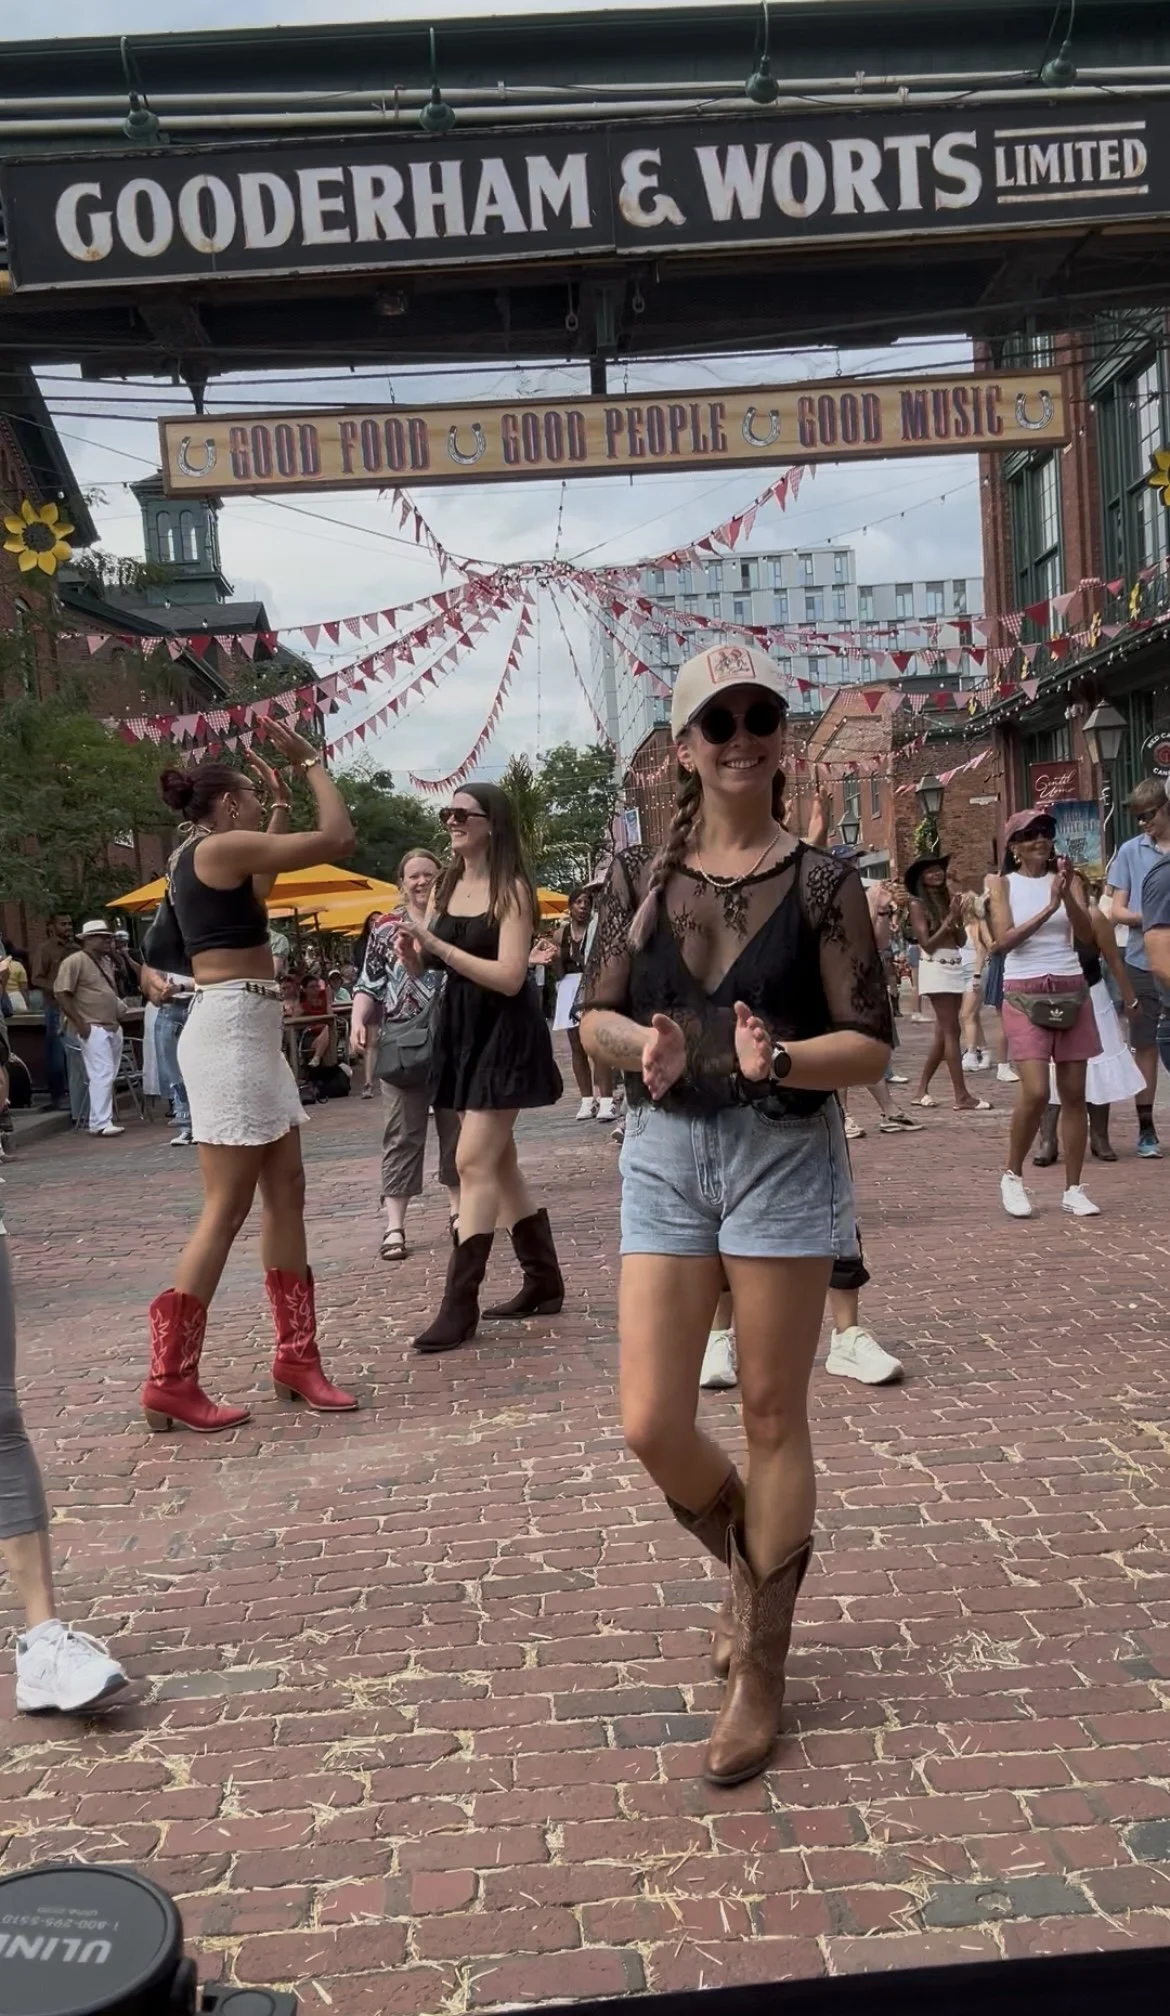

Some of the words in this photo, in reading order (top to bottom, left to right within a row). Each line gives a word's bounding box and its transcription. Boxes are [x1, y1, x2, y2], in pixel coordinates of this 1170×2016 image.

[55, 153, 593, 262] GOODERHAM
[618, 148, 687, 228] &
[694, 130, 983, 222] WORTS
[994, 137, 1148, 188] LIMITED
[229, 422, 322, 480] GOOD
[338, 417, 431, 475] FOOD
[501, 410, 588, 466] GOOD
[603, 401, 729, 460] PEOPLE
[798, 392, 883, 449] GOOD
[900, 384, 1005, 442] MUSIC
